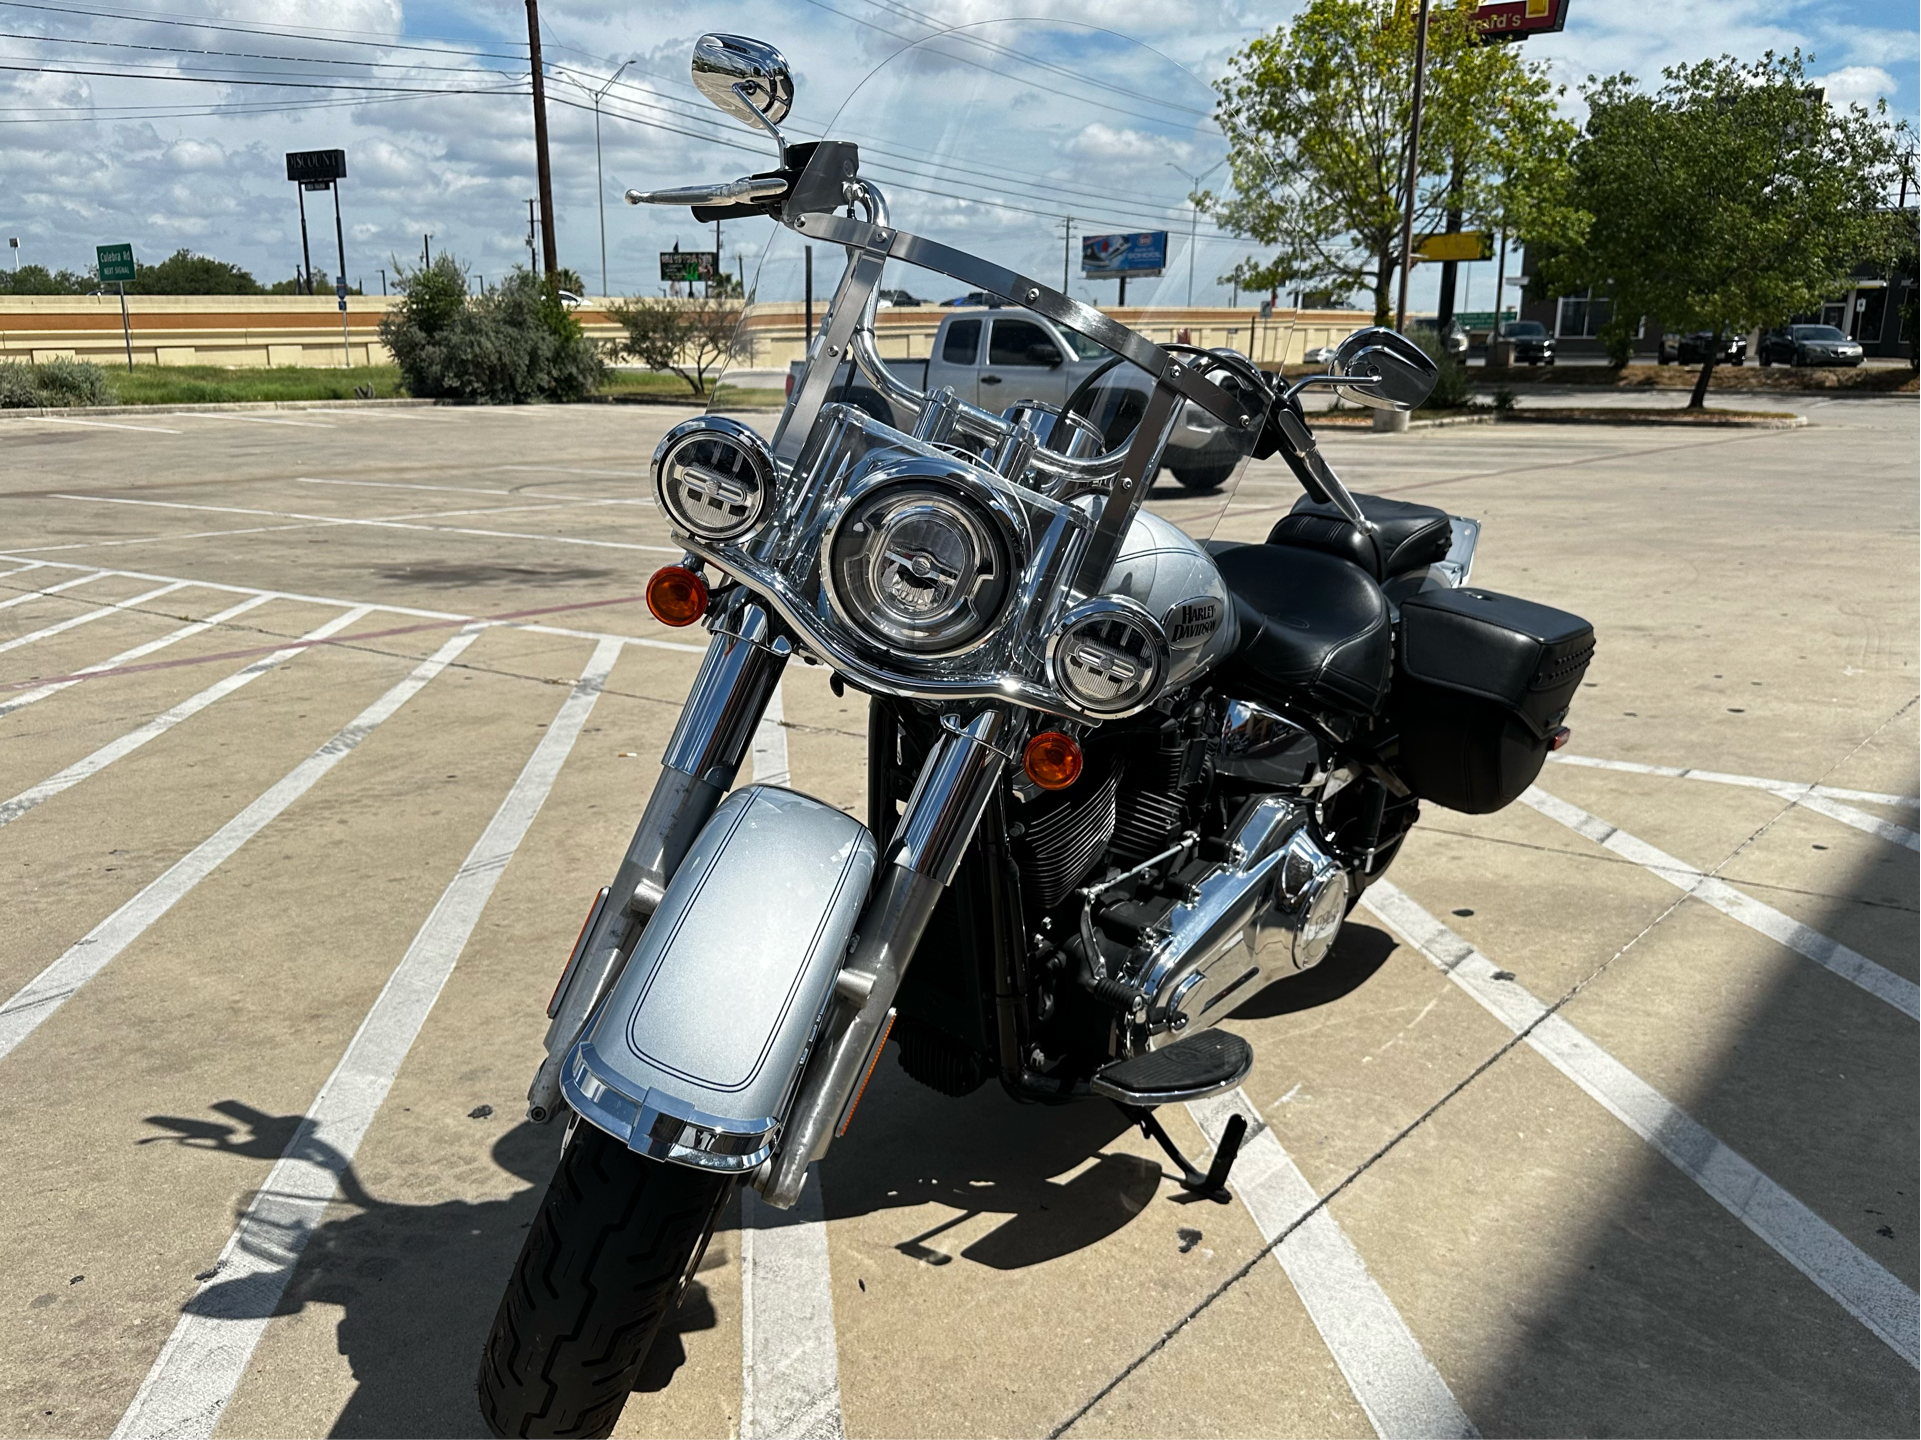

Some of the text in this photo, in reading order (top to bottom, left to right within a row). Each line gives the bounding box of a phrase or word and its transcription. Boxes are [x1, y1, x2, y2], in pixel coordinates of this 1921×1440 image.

[288, 152, 337, 168] DISCOUNT
[100, 250, 131, 262] Culebra Rd
[1171, 619, 1217, 642] DAVIDSON
